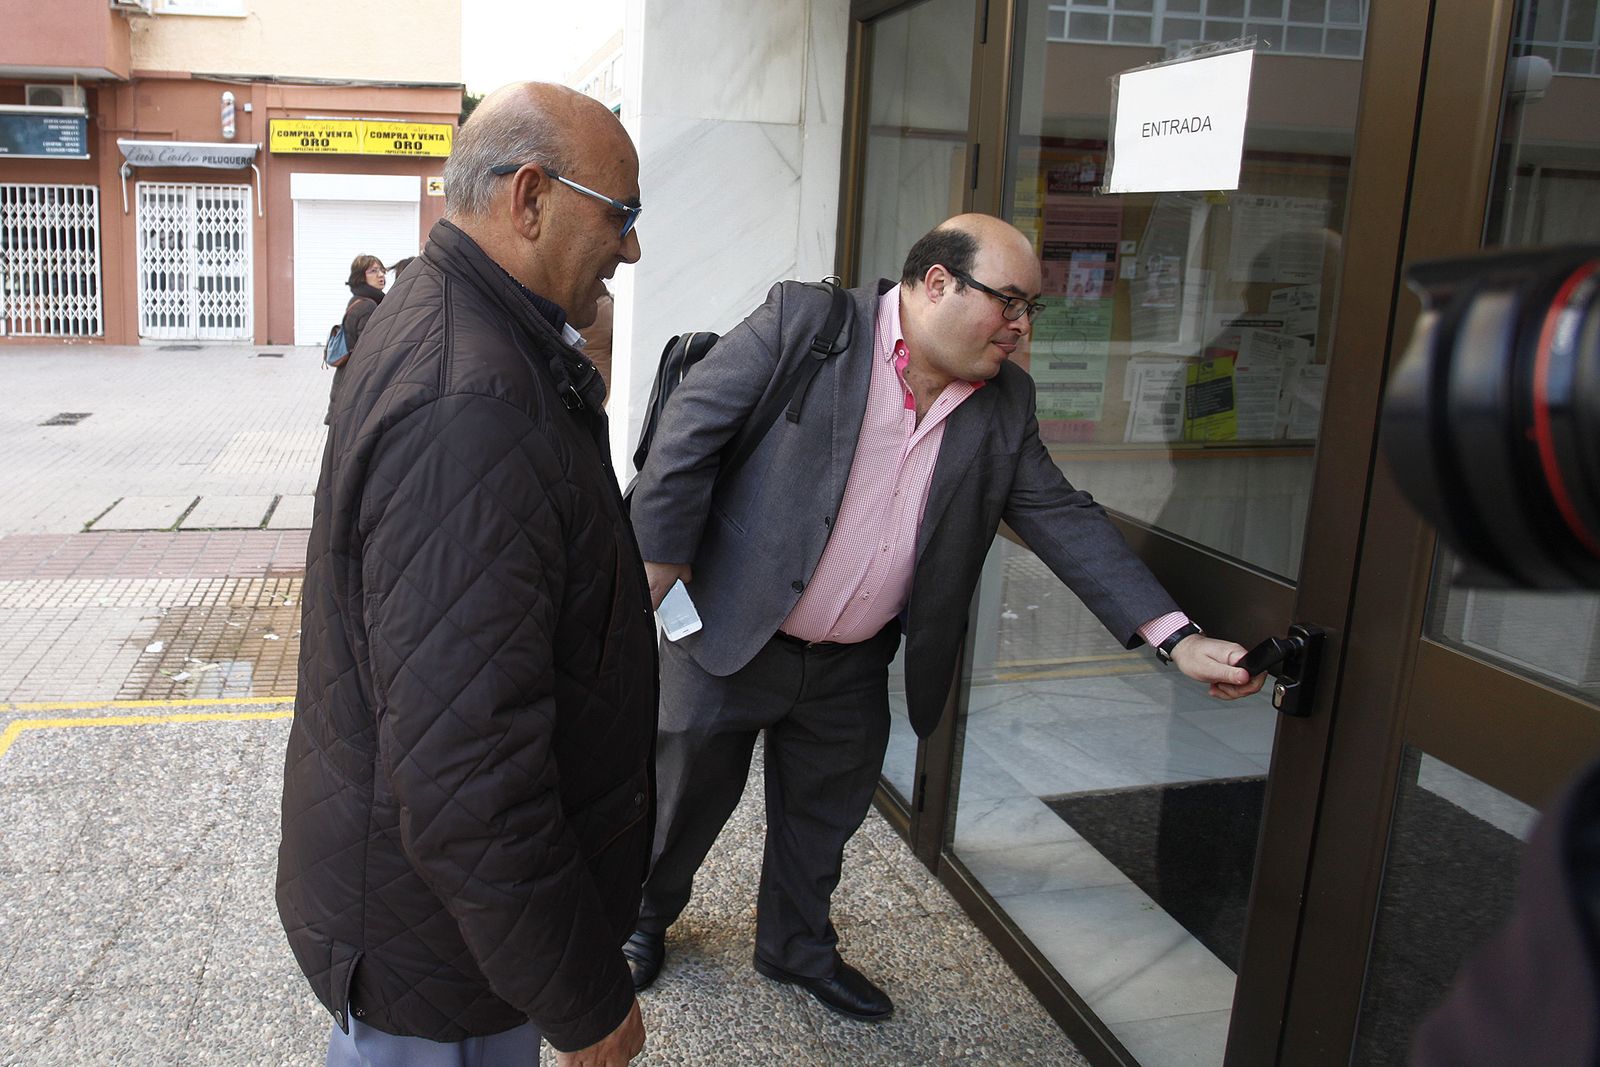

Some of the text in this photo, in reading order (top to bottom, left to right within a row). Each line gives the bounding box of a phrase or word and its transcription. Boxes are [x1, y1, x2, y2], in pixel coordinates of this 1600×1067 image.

[1142, 115, 1212, 138] ENTRADA
[276, 130, 315, 138] COMPRA
[318, 130, 323, 138] Y
[369, 131, 445, 141] COMPRA Y VENTA
[300, 138, 330, 147] ORO
[393, 140, 423, 150] ORO
[201, 155, 252, 165] PELUQUERO
